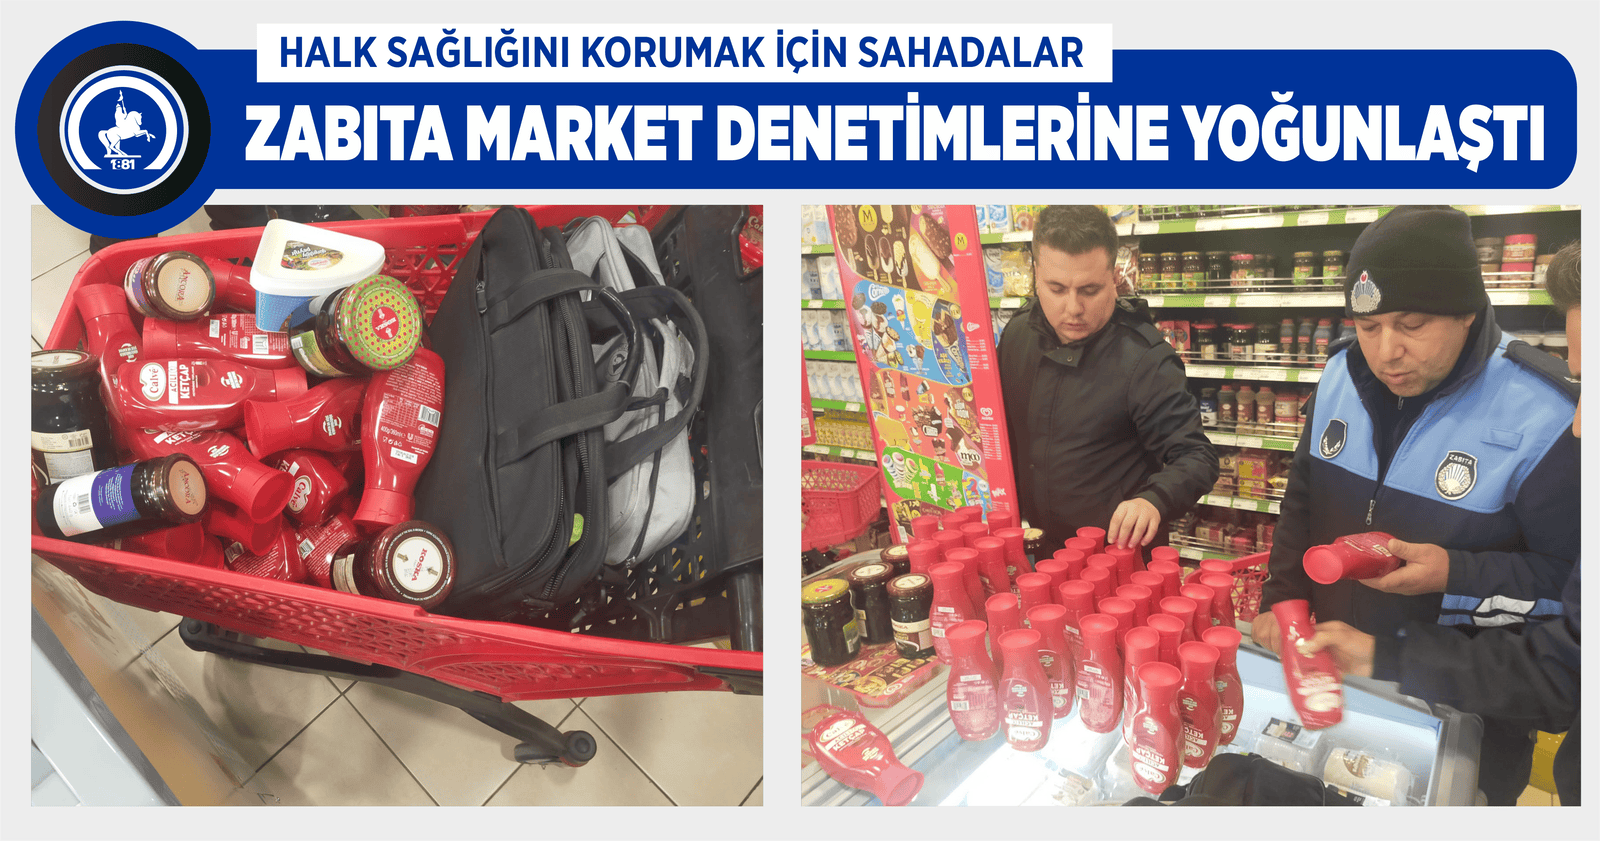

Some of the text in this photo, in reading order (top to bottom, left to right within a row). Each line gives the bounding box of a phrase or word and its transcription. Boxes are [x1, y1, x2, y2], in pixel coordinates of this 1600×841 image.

[148, 367, 159, 394] Calvé
[179, 364, 192, 399] KETÇAP
[1449, 454, 1473, 465] ZABITA
[290, 481, 306, 508] Calvé
[411, 547, 428, 582] KOSKA
